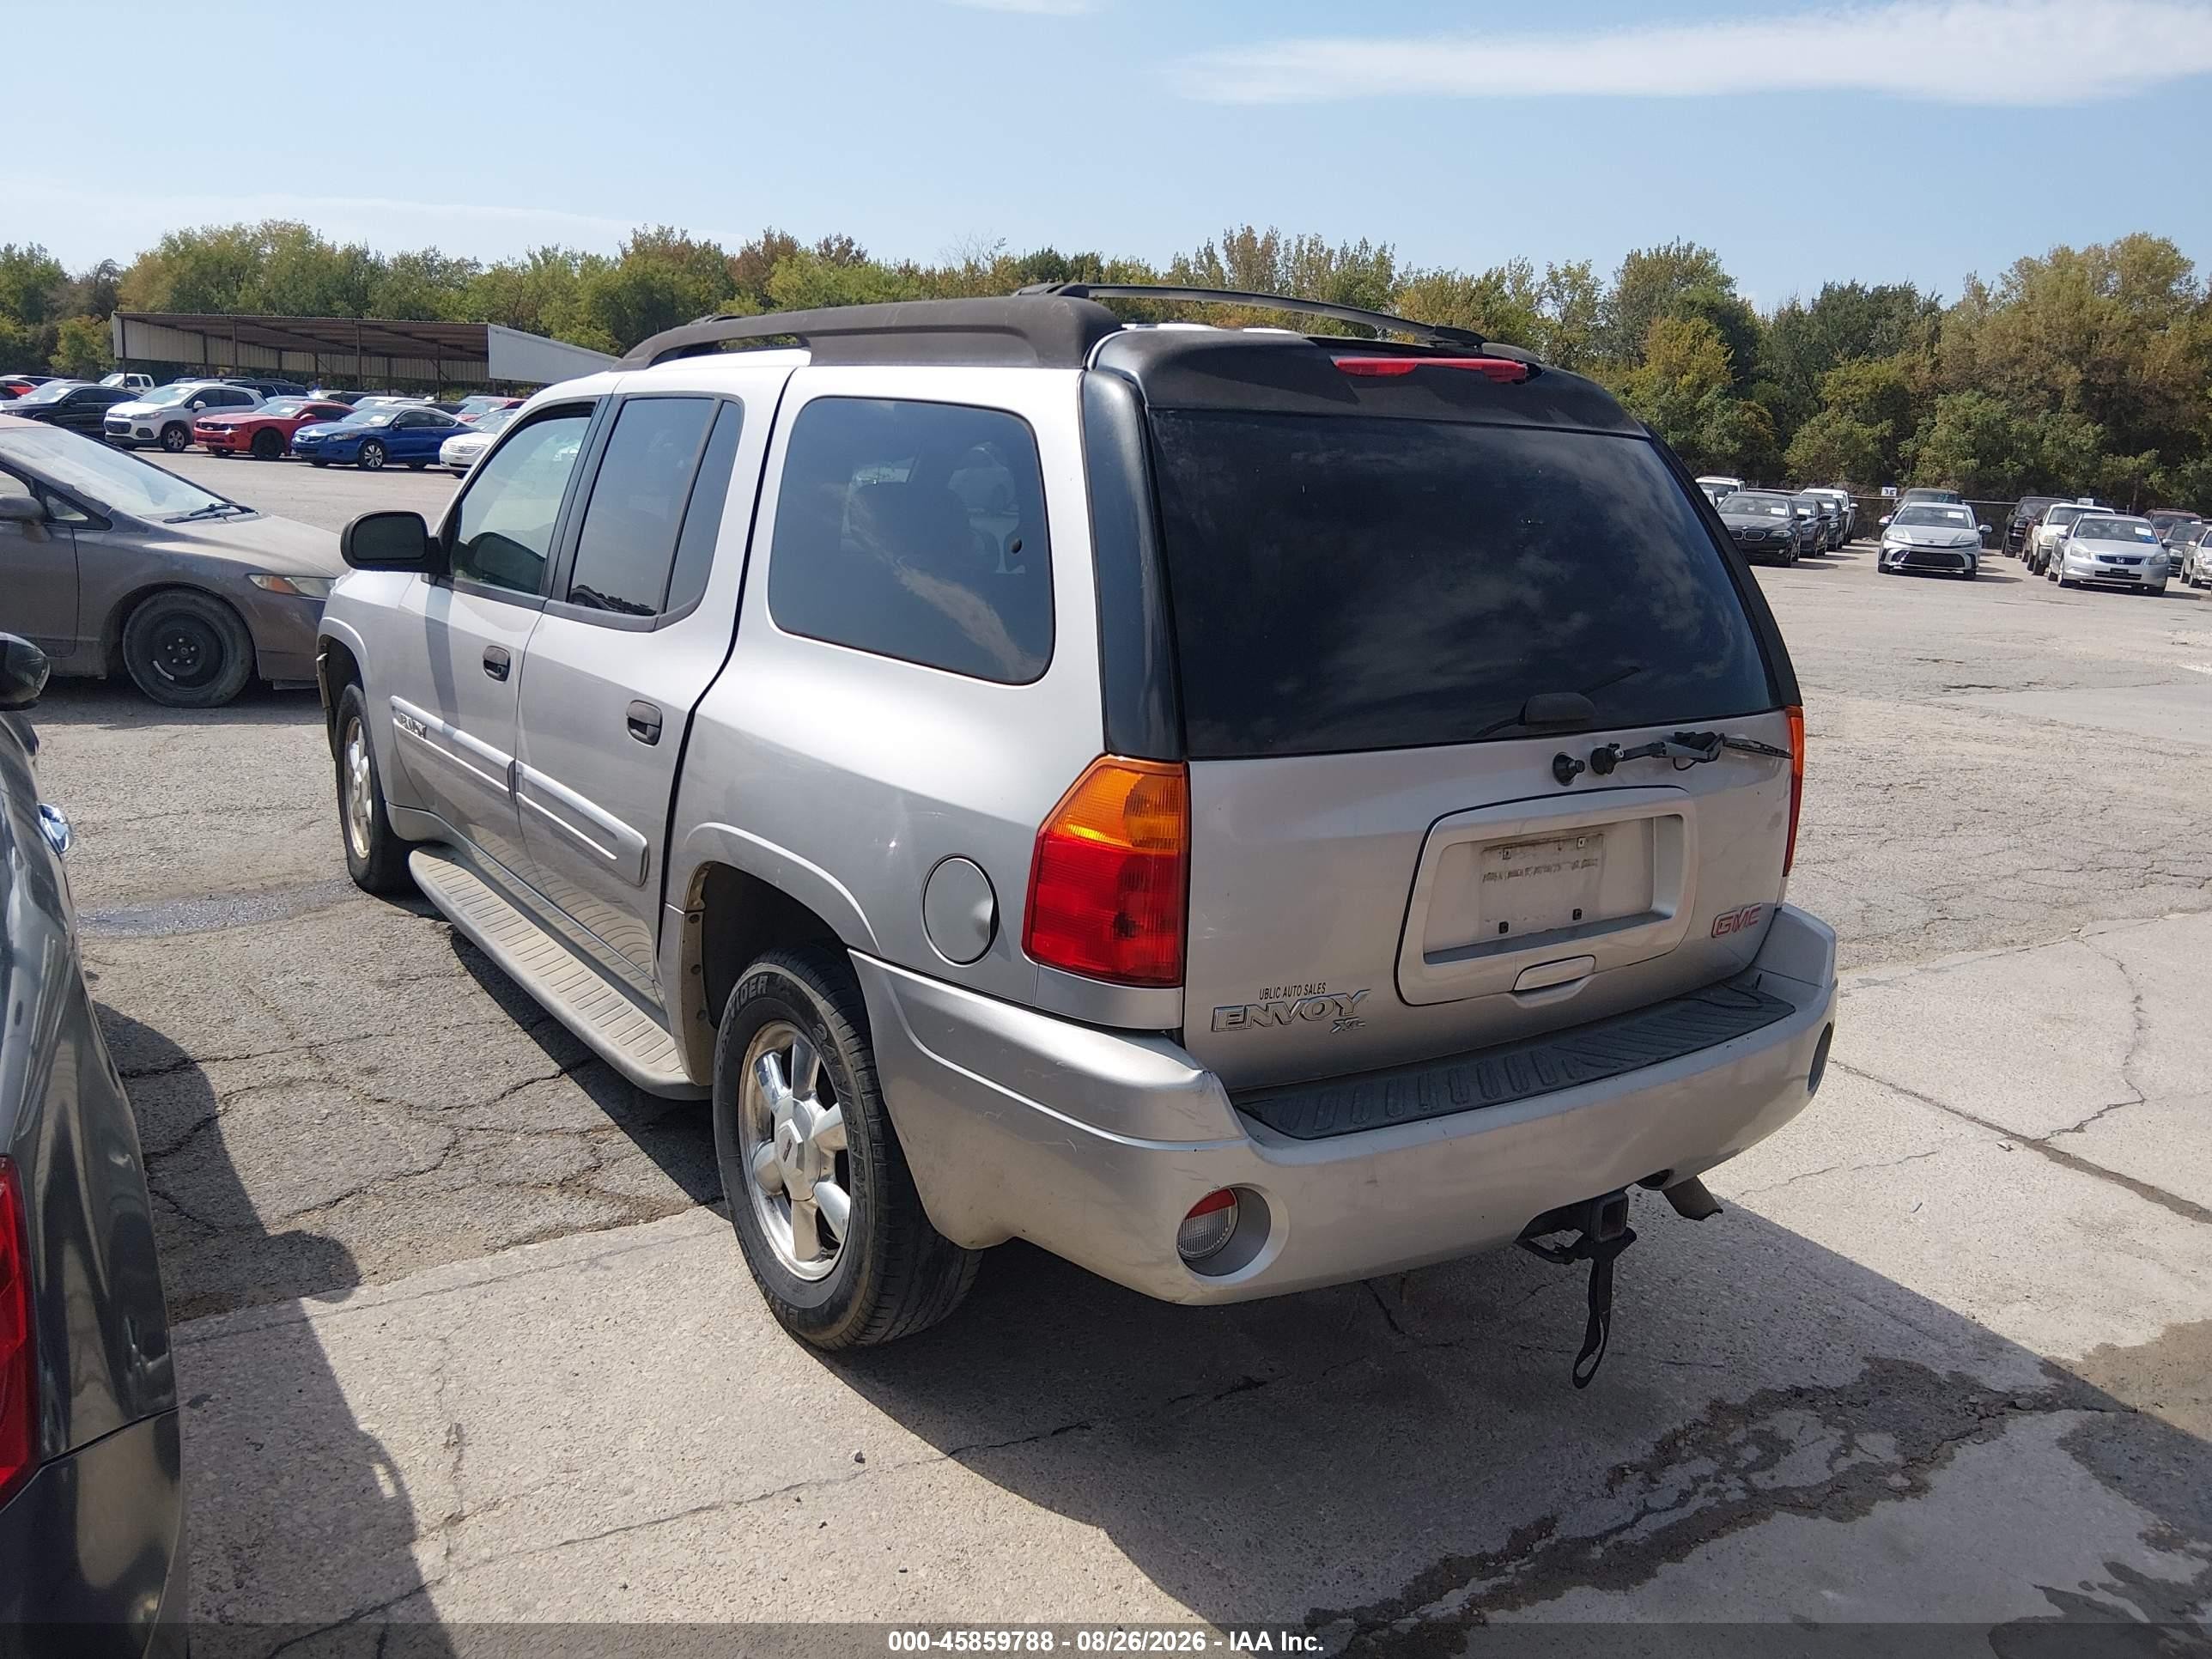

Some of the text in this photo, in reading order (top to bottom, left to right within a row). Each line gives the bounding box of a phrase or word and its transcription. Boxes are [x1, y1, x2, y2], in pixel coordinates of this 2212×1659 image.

[1711, 902, 1761, 938] GMC
[1259, 981, 1327, 1000] UBLIC AUTO SALES
[1211, 988, 1371, 1032] ENVOY
